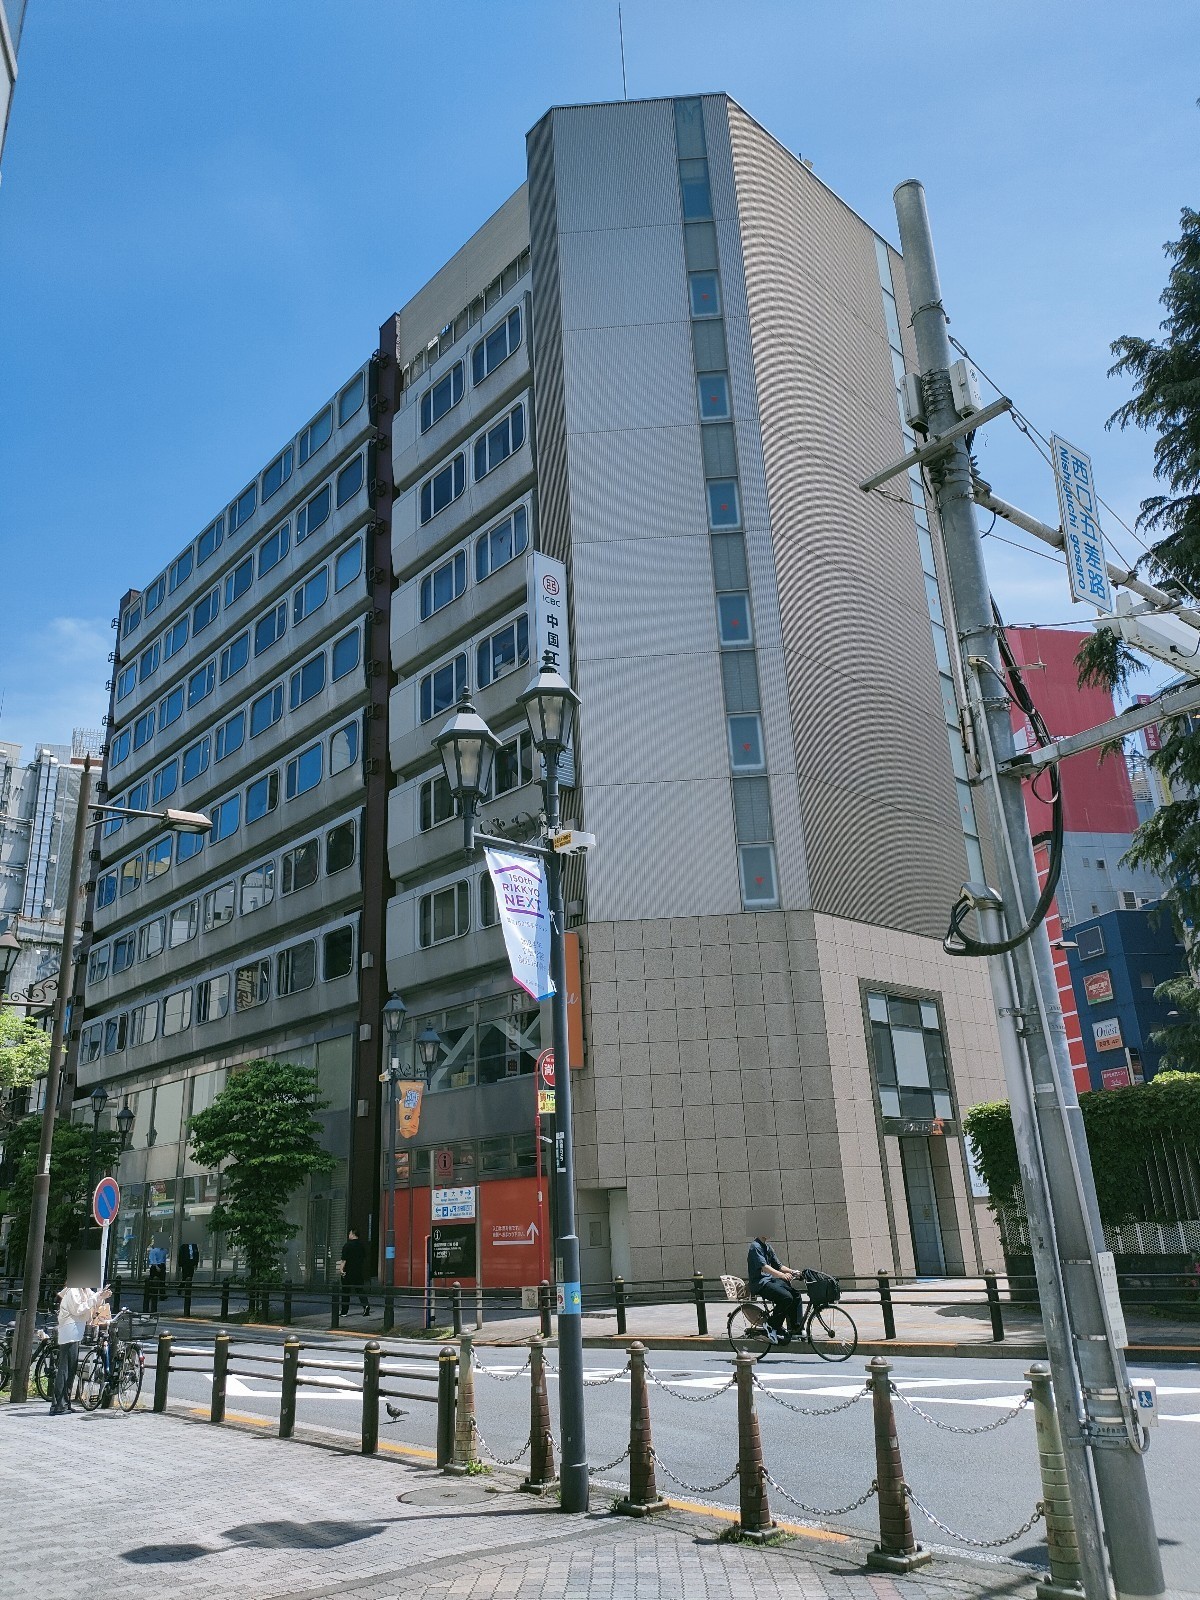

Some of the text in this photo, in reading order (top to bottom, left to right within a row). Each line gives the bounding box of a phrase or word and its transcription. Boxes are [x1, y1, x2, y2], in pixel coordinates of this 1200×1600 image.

[1059, 446, 1086, 590] Nishiguchi gosaro
[1071, 454, 1106, 600] 西口五差路
[542, 595, 561, 607] ICBC
[508, 873, 534, 886] 150th
[502, 882, 541, 898] RIKKYO
[504, 894, 542, 911] NEXT
